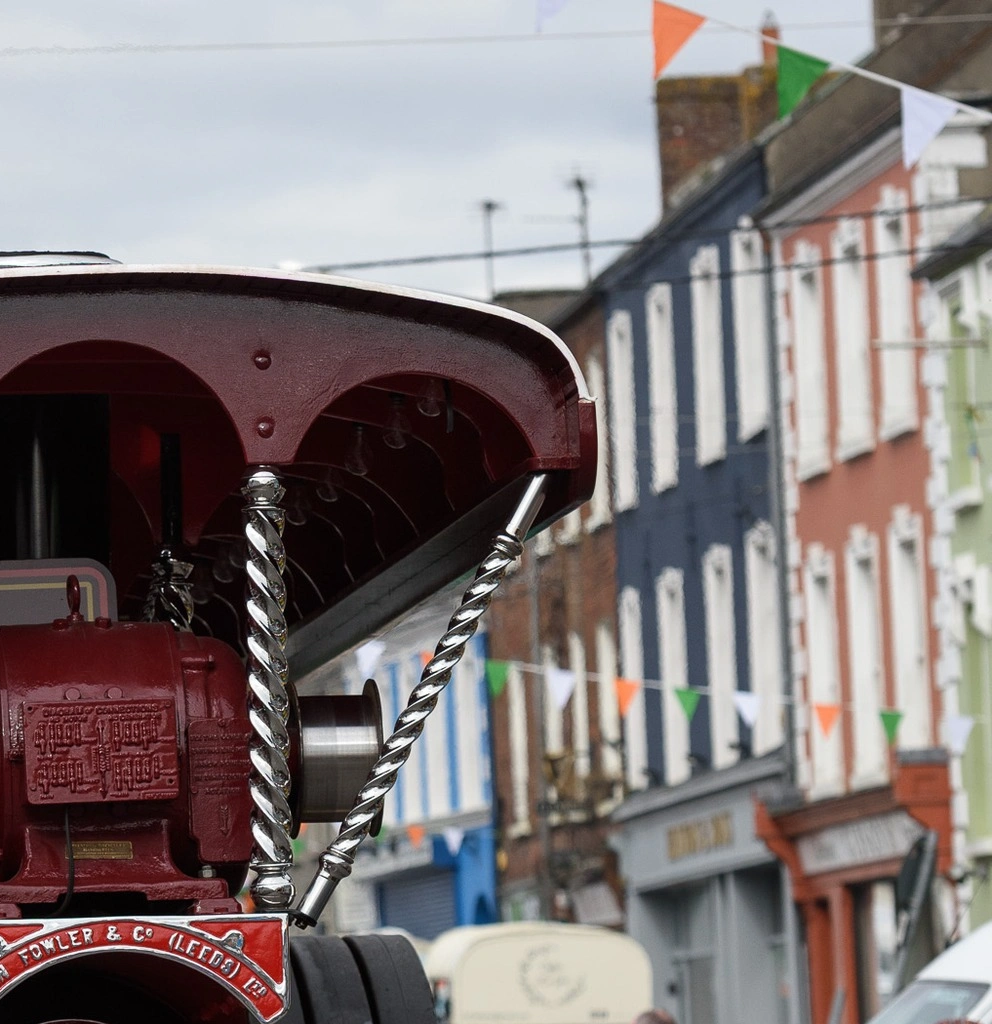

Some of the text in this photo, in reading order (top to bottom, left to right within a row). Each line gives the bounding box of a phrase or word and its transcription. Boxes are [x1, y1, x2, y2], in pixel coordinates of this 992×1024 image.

[18, 927, 94, 967] FOWLER
[107, 925, 122, 941] &
[168, 932, 241, 979] (LEEDS)
